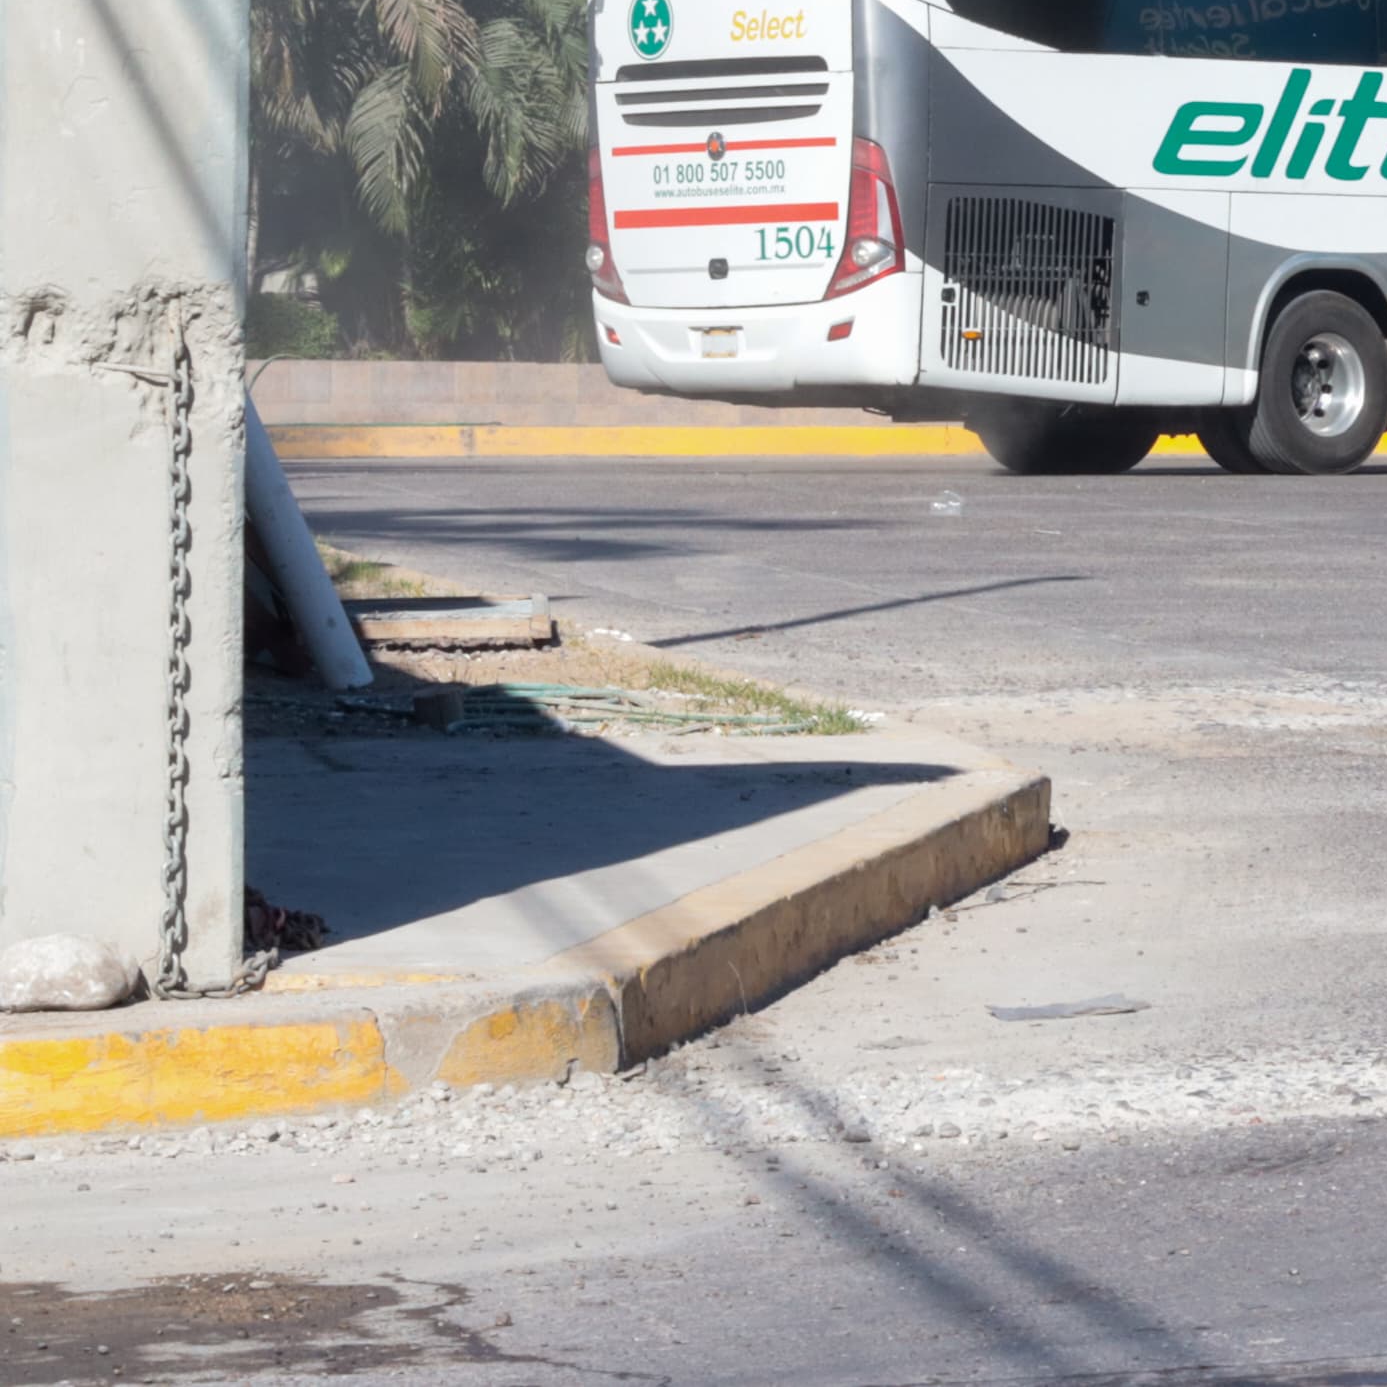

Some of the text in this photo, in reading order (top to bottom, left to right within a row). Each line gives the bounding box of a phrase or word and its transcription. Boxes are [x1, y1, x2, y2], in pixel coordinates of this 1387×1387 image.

[730, 9, 807, 41] Select
[653, 159, 785, 184] 01 800 507 5500
[654, 184, 785, 198] www.autobuseselite.com.mx
[754, 225, 835, 261] 1504
